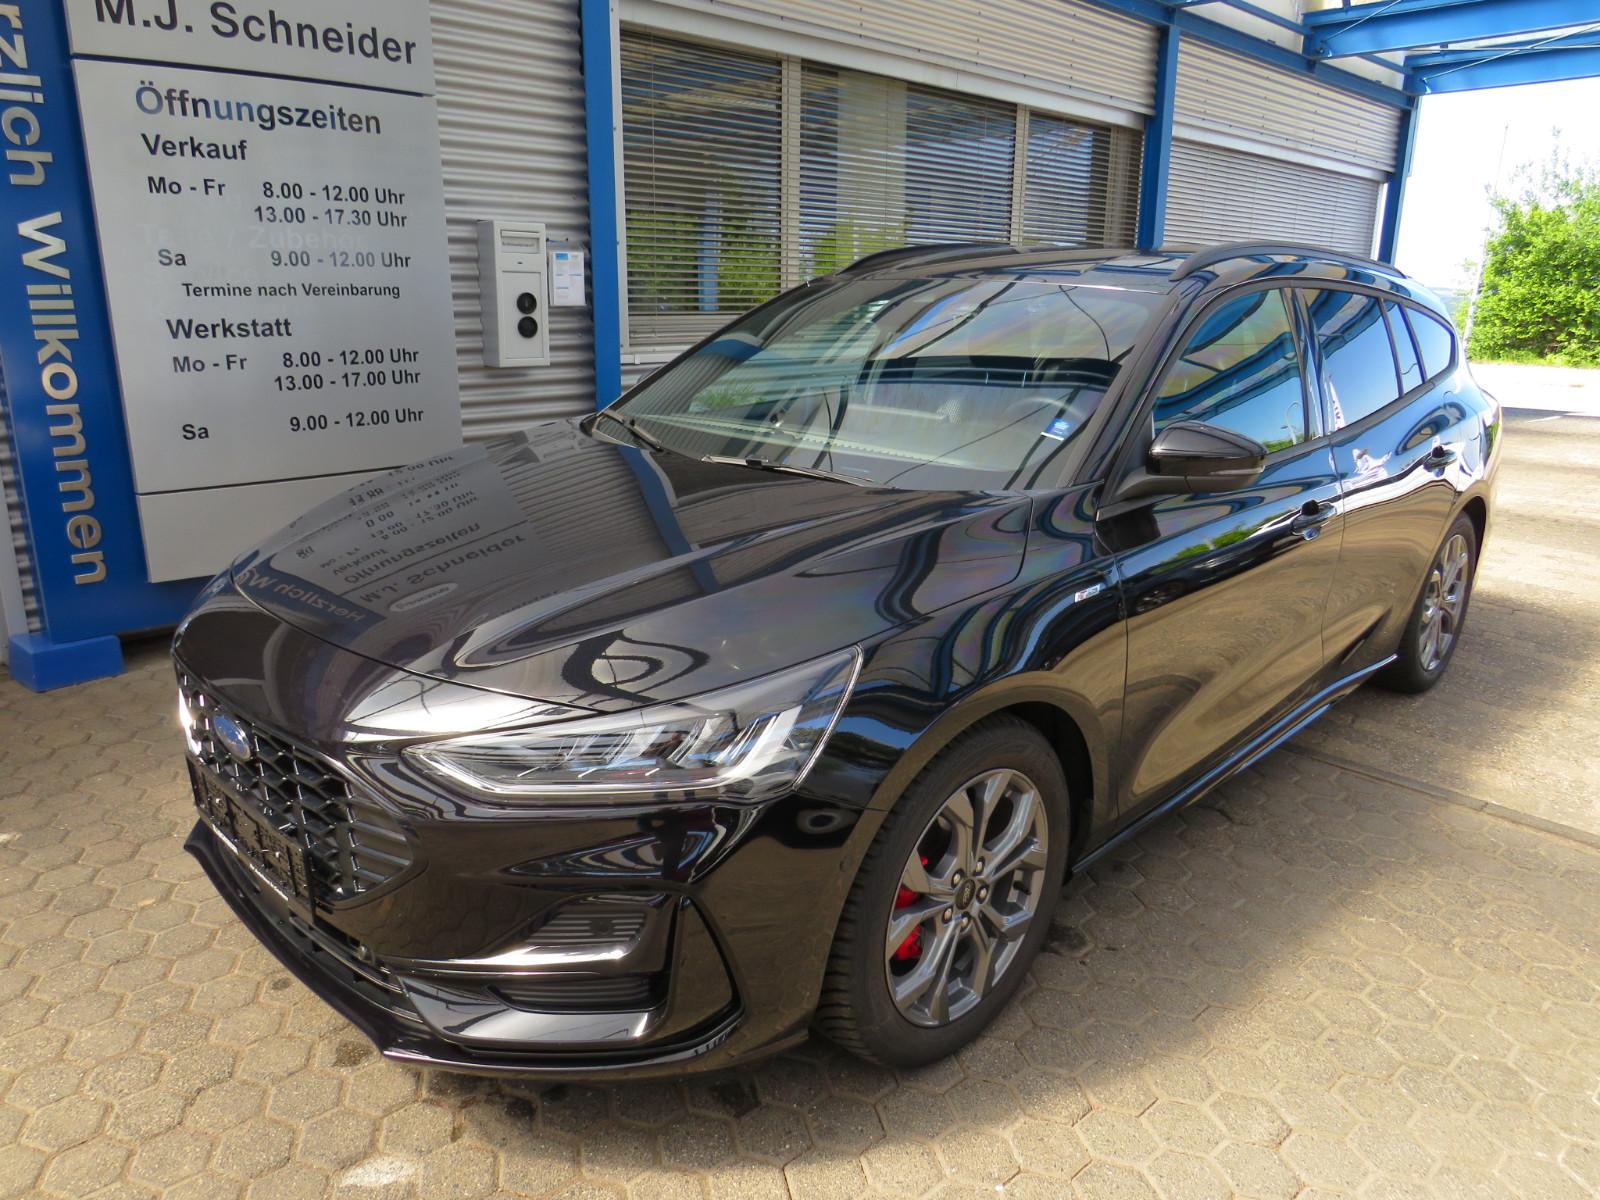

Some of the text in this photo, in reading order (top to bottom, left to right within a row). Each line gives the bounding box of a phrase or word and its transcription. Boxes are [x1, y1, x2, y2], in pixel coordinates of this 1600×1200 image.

[95, 0, 417, 64] M.J. Schneider
[135, 80, 381, 134] Öffnungszeiten
[141, 132, 248, 161] Verkauf
[147, 176, 182, 195] Mo
[203, 178, 226, 196] Fr
[262, 181, 303, 200] 8.00
[322, 184, 369, 203] 12.00
[375, 187, 405, 205] Uhr
[254, 205, 306, 224] 13.00
[324, 208, 371, 226] 17.30
[377, 210, 407, 228] Uhr
[158, 248, 187, 267] Sa
[270, 250, 311, 267] 9.00
[329, 251, 376, 268] 12.00
[381, 251, 411, 268] Uhr
[181, 282, 401, 300] Termine nach Vereinbarung
[166, 318, 292, 340] Werkstatt
[172, 356, 205, 373] Mo
[226, 354, 247, 370] Fr
[282, 351, 321, 368] 8.00
[339, 349, 384, 366] 12.00
[390, 347, 419, 363] Uhr
[274, 373, 324, 392] 13.00
[341, 370, 386, 388] 17.00
[391, 369, 421, 385] Uhr
[17, 211, 107, 585] Willkommen
[182, 423, 209, 440] Sa
[290, 414, 328, 432] 9.00
[345, 409, 390, 428] 12.00
[395, 407, 424, 424] Uhr
